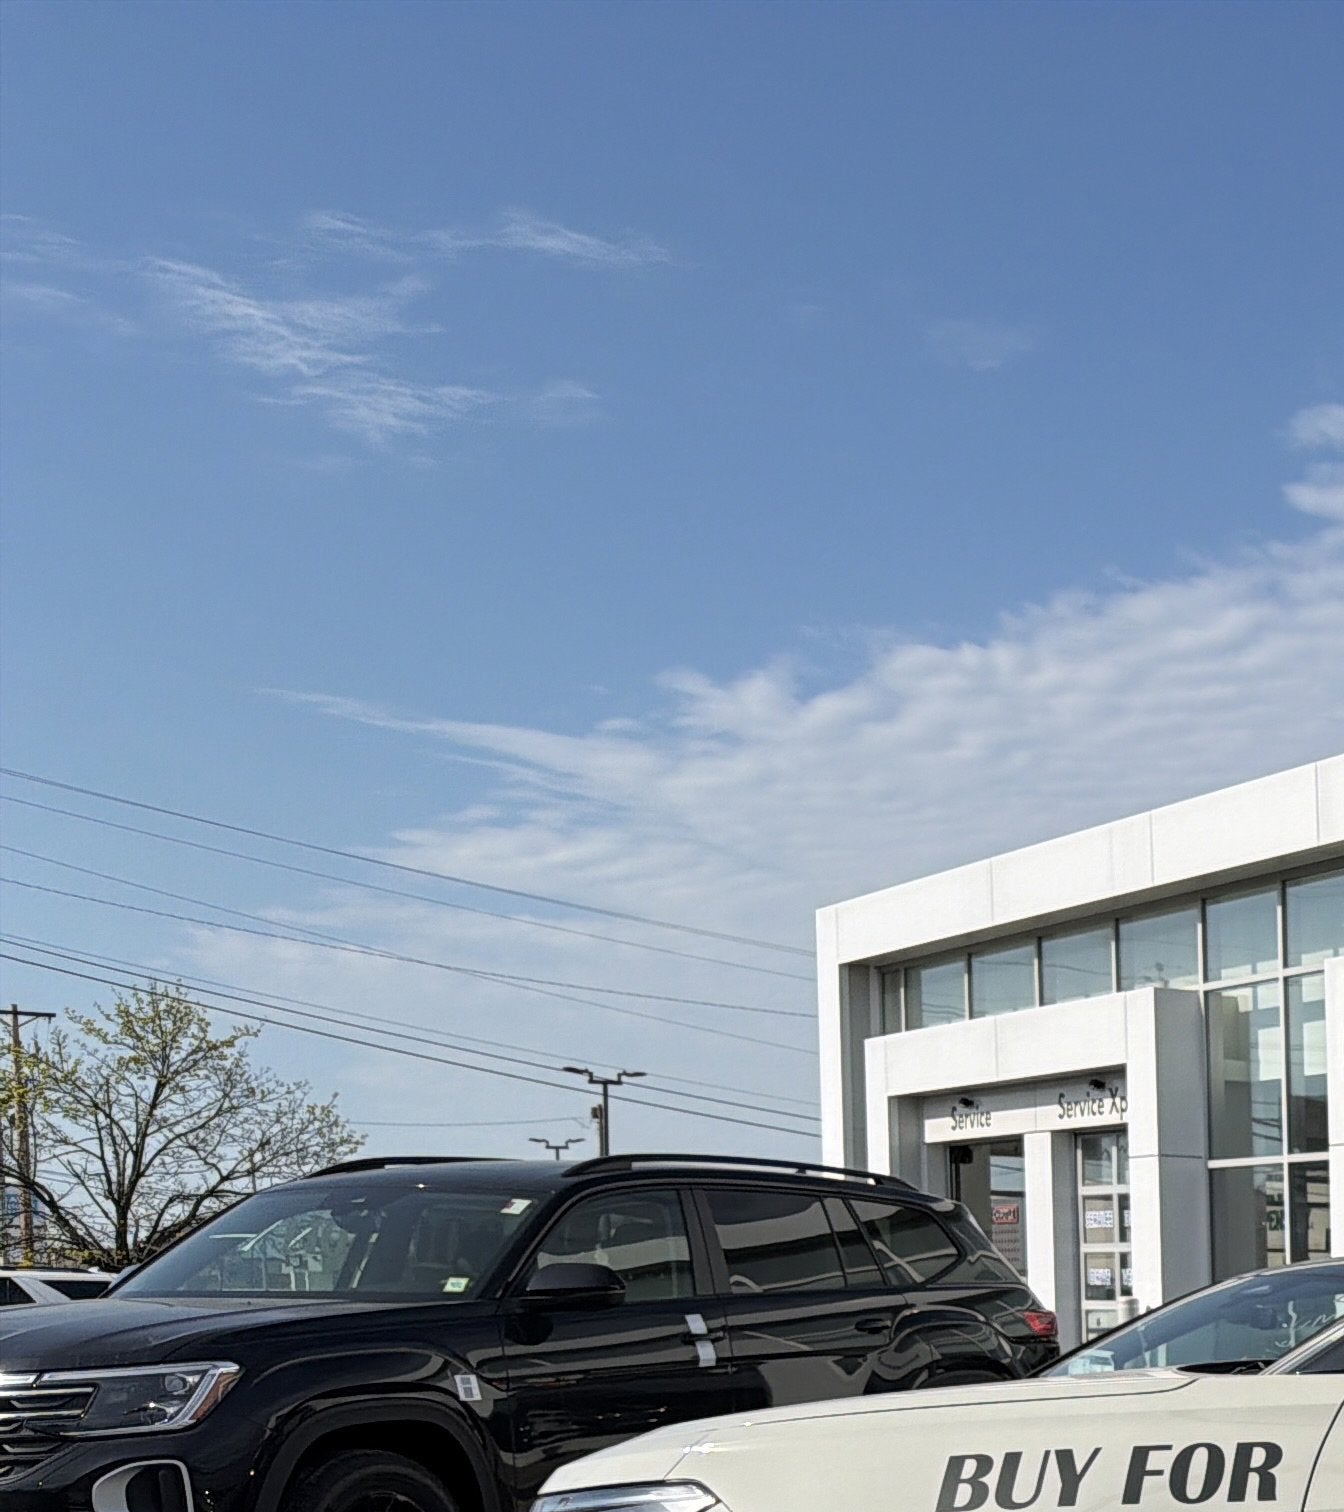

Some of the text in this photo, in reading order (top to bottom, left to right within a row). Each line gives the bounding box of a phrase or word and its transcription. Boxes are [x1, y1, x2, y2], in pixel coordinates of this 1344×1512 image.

[951, 1105, 992, 1131] Service
[1058, 1091, 1105, 1120] Service
[935, 1441, 1284, 1512] BUY FOR
